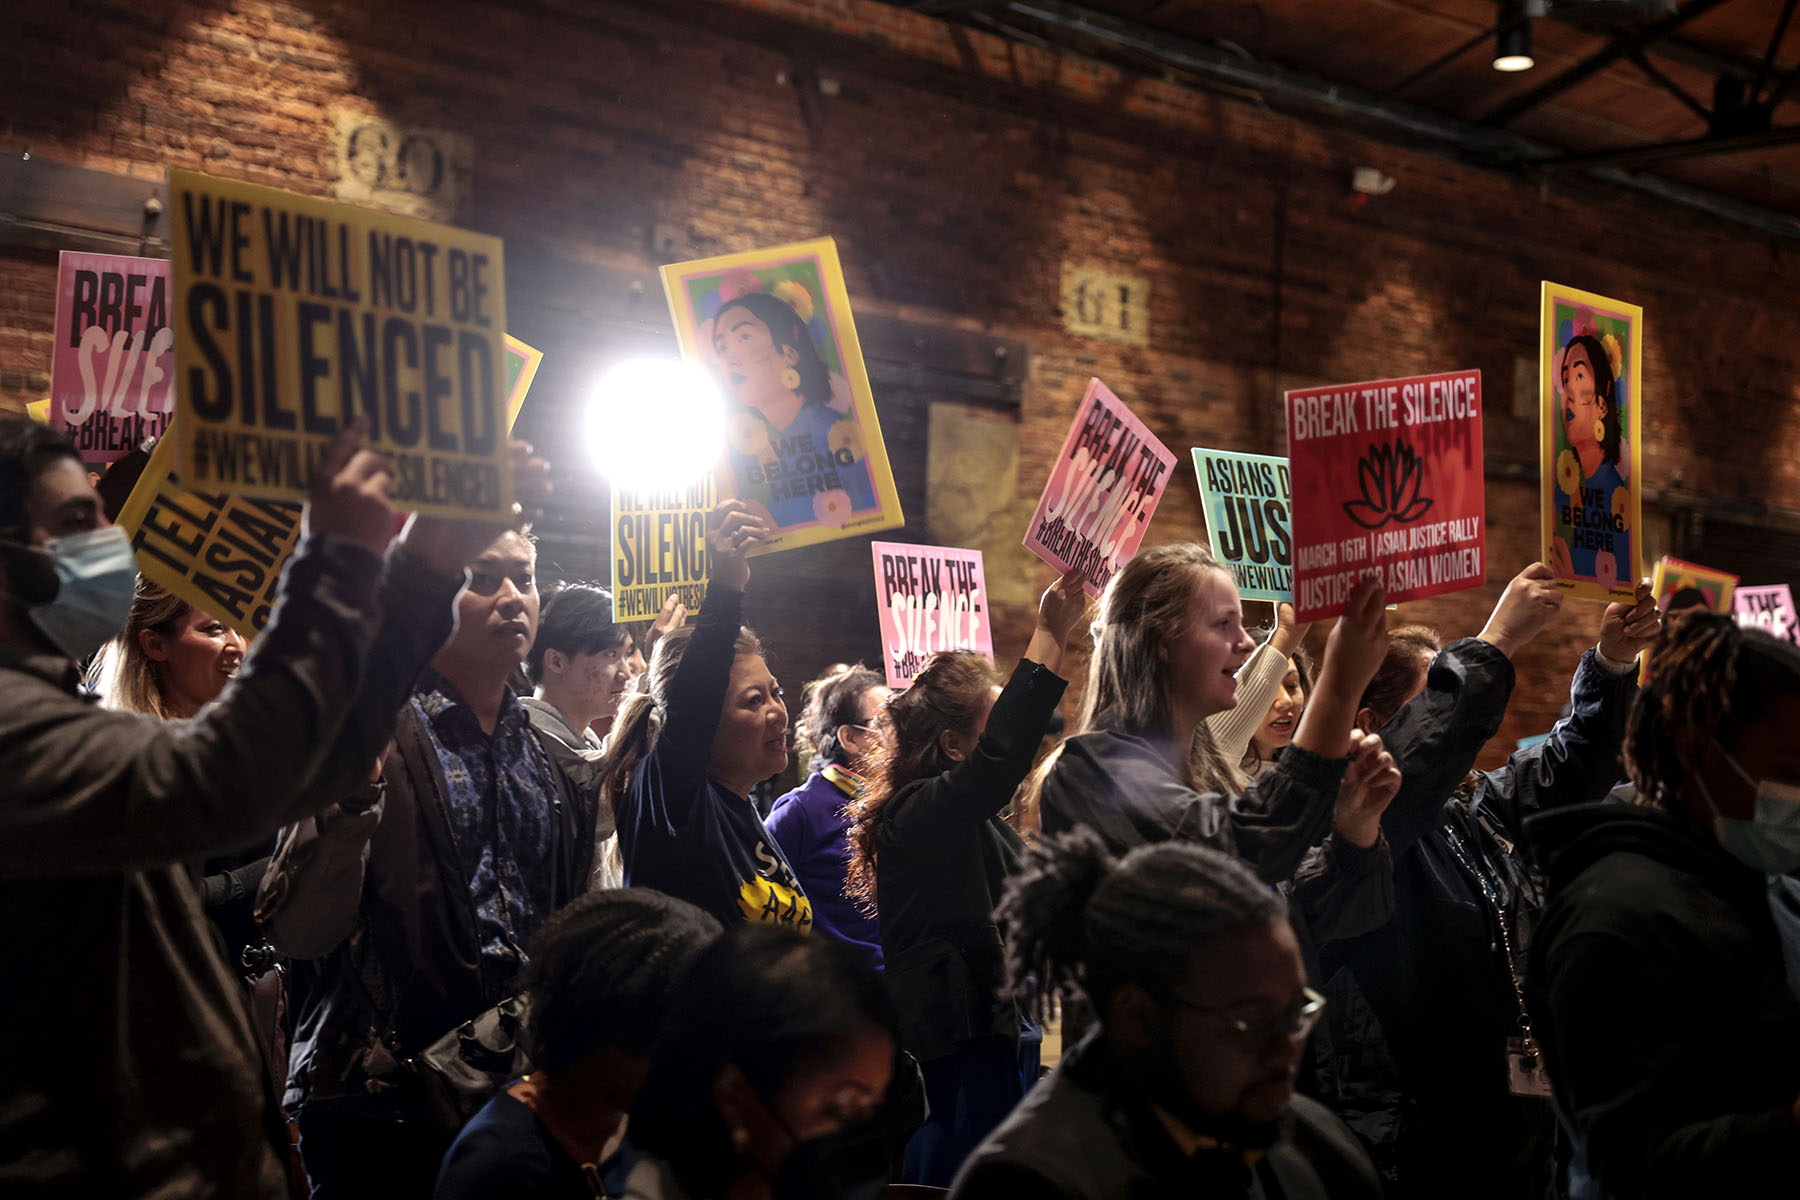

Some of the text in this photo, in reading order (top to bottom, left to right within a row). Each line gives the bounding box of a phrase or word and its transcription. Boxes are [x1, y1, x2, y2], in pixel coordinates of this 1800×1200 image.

[182, 190, 494, 328] WE WILL NOT BE
[187, 282, 498, 456] SILENCED
[1294, 376, 1478, 441] BREAK THE SILENCE
[746, 447, 855, 486] BELONG
[771, 432, 816, 458] WE
[1070, 398, 1168, 523] BREAK THE
[770, 471, 843, 503] HERE
[1205, 456, 1277, 498] ASIANS
[1579, 486, 1605, 510] WE
[131, 471, 231, 577] TELL
[1044, 446, 1154, 574] SILENCE
[1218, 496, 1292, 566] JUS
[1561, 504, 1625, 534] BELONG
[1573, 527, 1615, 553] HERE
[1298, 541, 1337, 572] MARCH
[1339, 537, 1367, 566] 16TH
[1376, 527, 1408, 558] ASIAN
[1408, 521, 1447, 550] JUSTICE
[1448, 516, 1480, 544] RALLY
[881, 554, 982, 613] BREAK THE
[1299, 569, 1356, 612] JUSTICE
[1387, 557, 1428, 594] ASIAN
[1430, 547, 1481, 586] WOMEN
[888, 589, 980, 663] SILENCE
